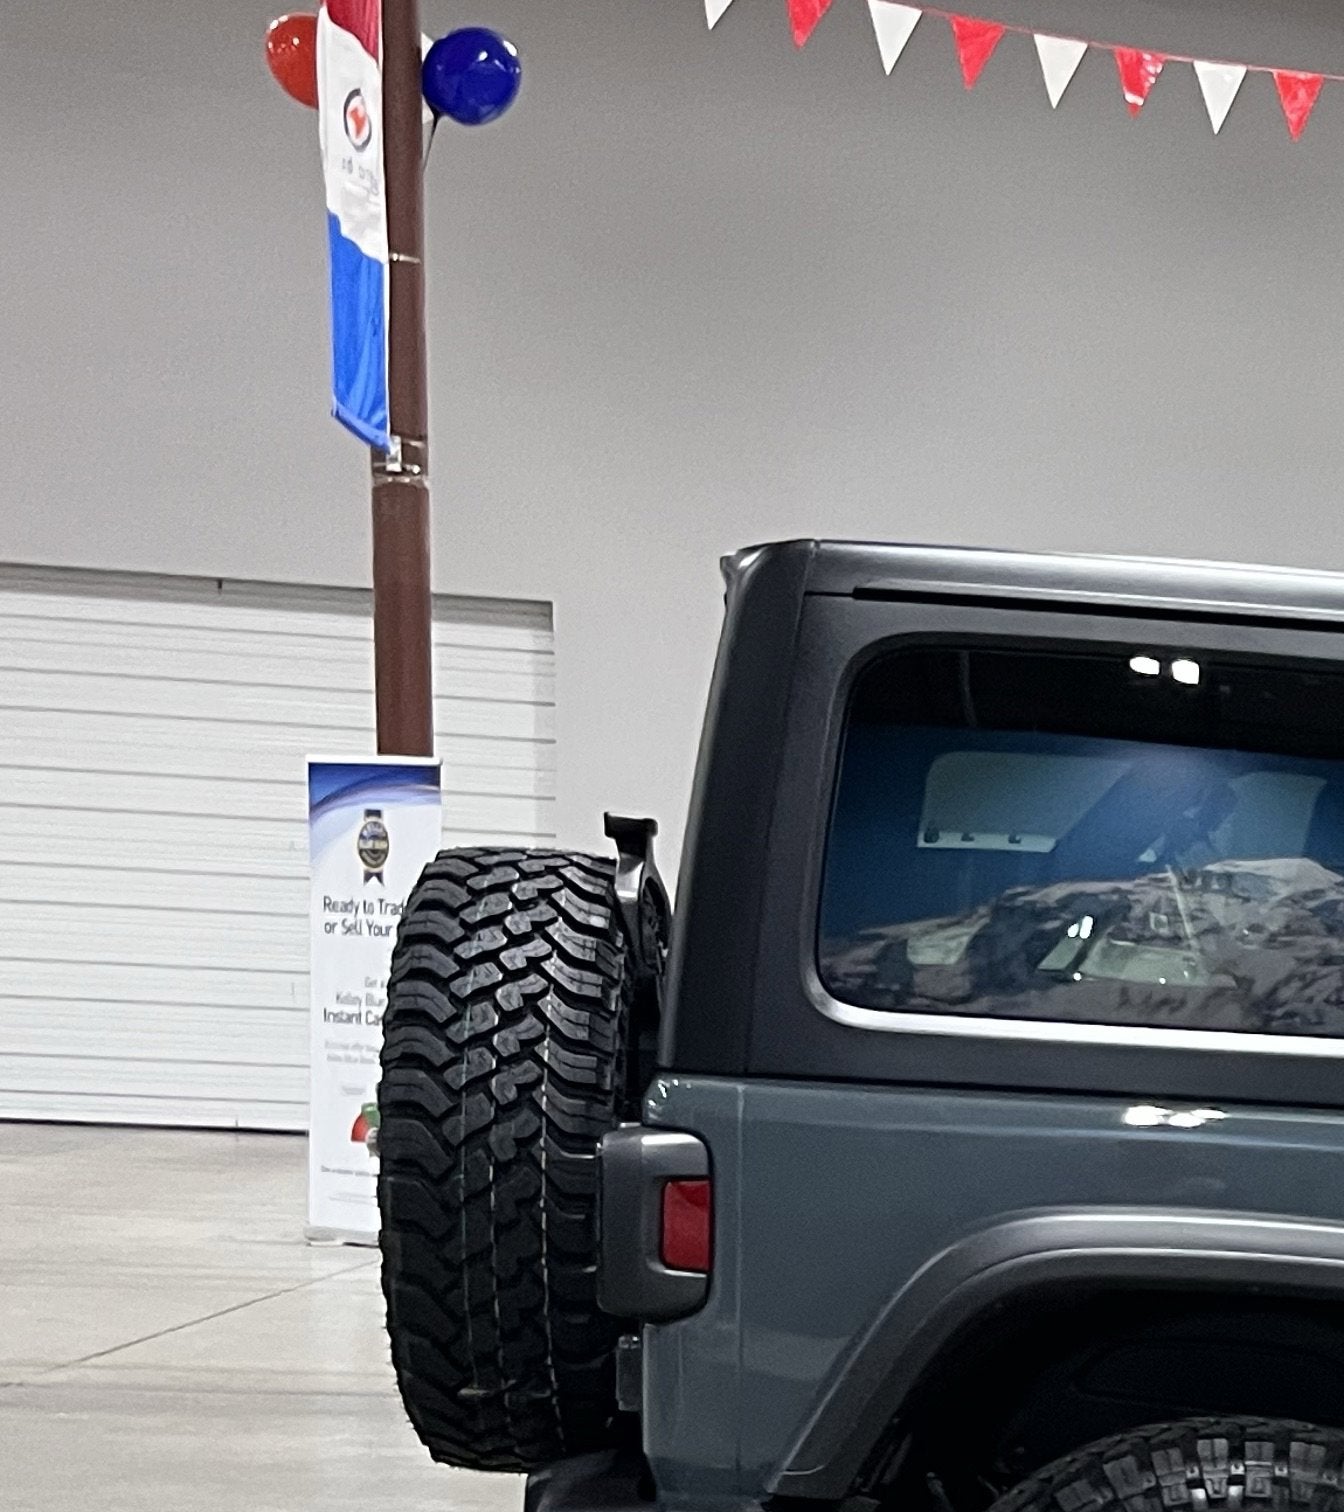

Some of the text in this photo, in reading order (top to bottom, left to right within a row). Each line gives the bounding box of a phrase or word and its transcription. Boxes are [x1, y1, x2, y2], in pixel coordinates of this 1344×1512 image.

[323, 895, 361, 918] Ready
[363, 898, 375, 914] to
[324, 918, 393, 937] or Sell Your
